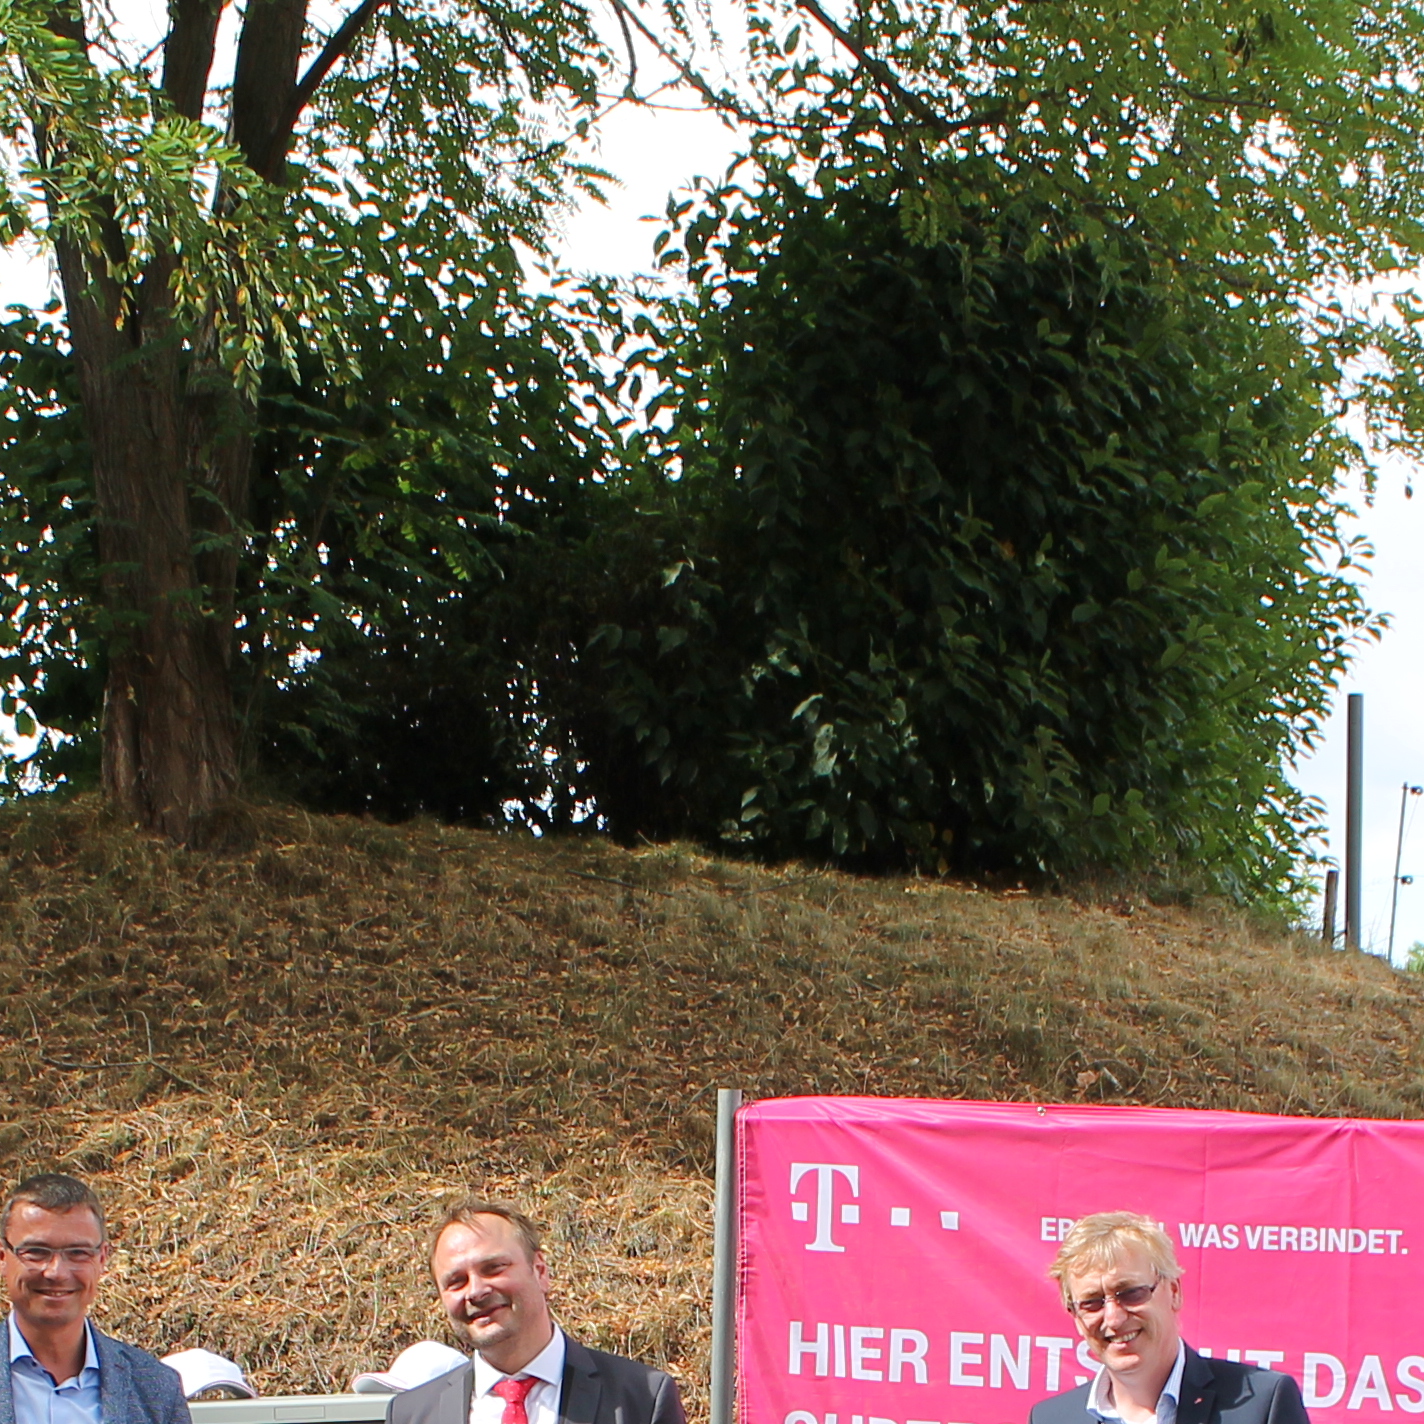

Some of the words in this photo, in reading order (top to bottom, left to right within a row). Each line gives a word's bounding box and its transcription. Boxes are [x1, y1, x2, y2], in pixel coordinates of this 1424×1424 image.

[1178, 1222, 1239, 1250] WAS
[1244, 1225, 1408, 1254] VERBINDET.
[788, 1321, 929, 1384] HIER
